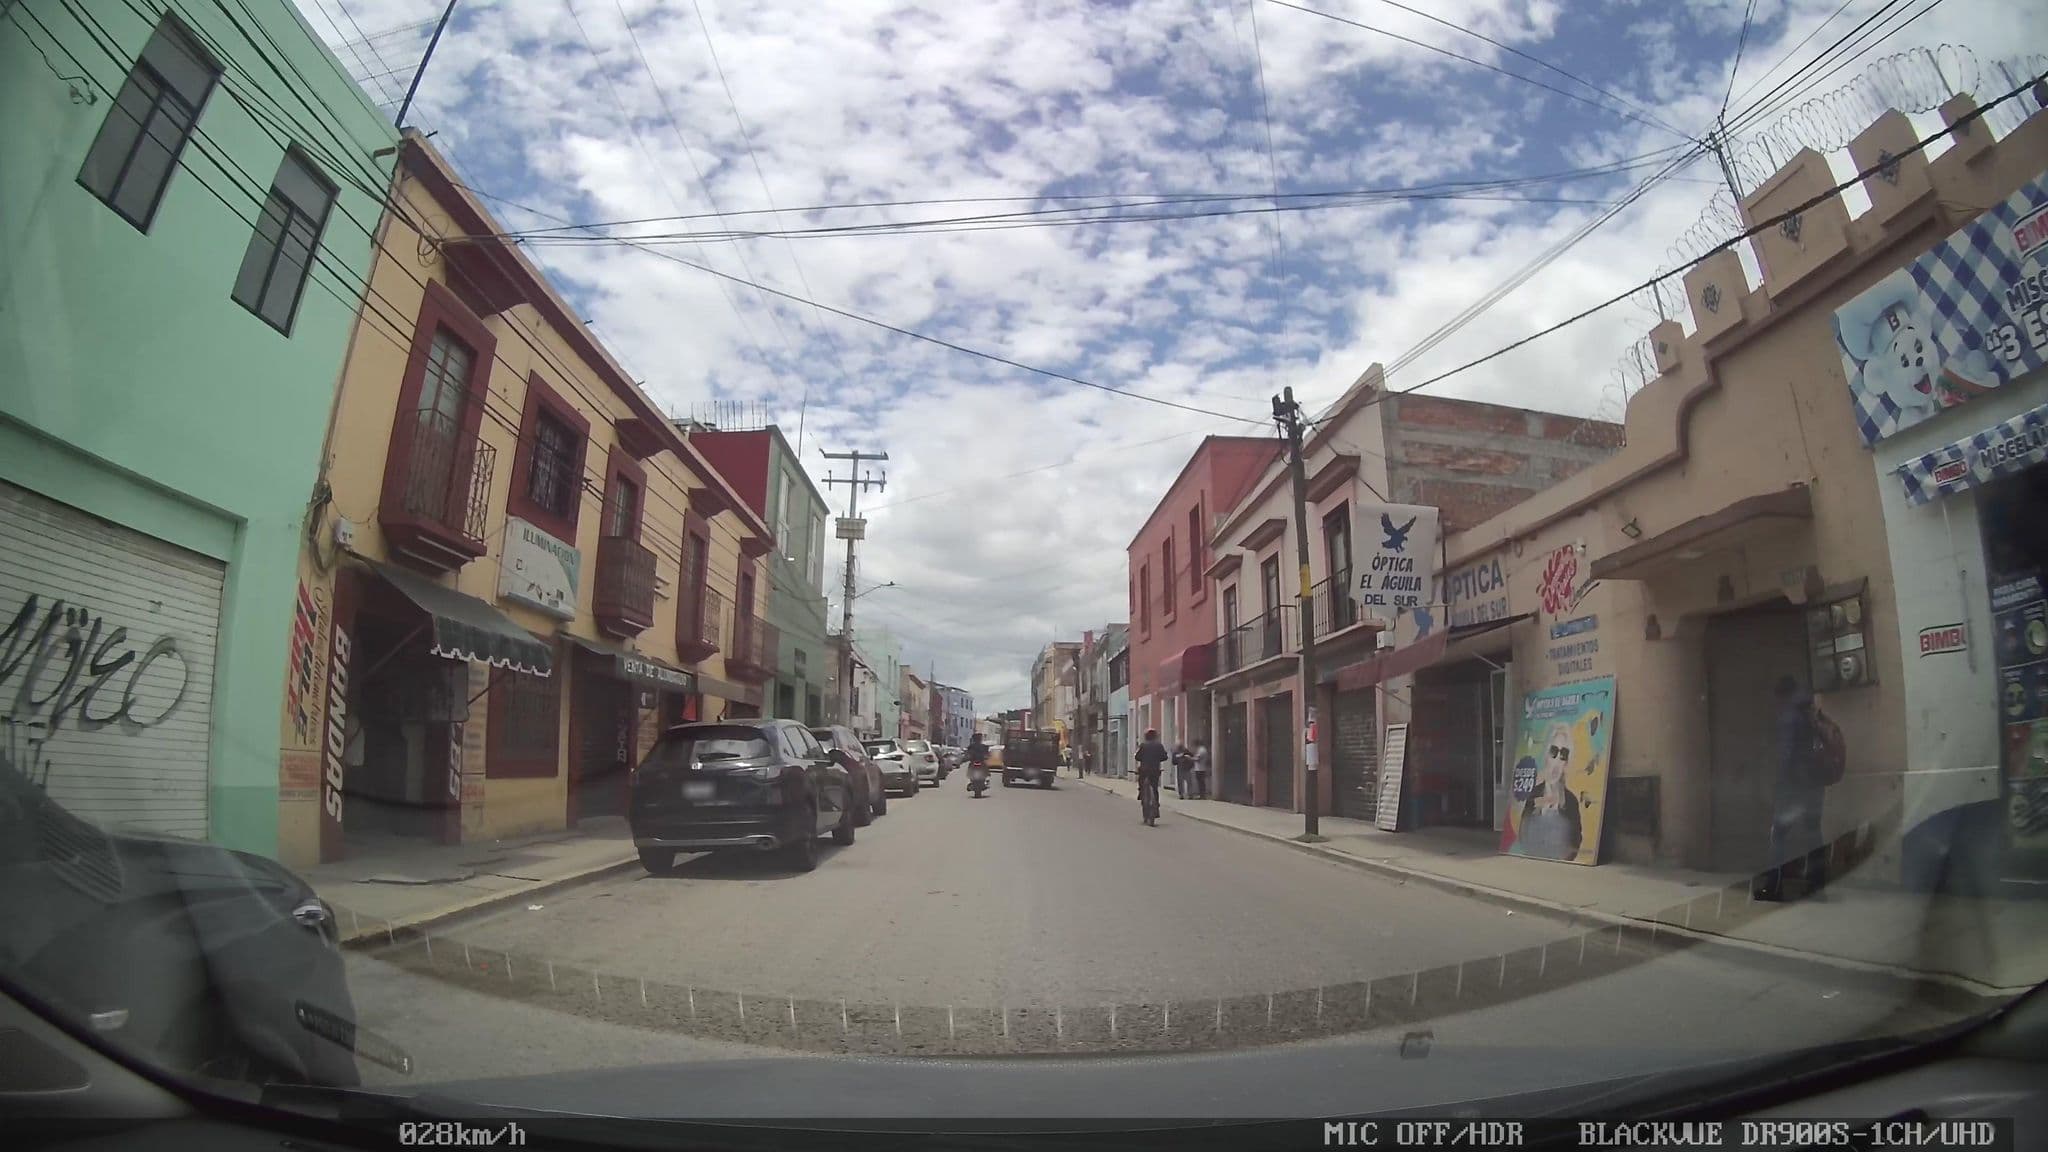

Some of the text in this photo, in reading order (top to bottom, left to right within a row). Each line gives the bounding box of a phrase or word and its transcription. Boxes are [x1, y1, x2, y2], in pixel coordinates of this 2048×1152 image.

[1360, 574, 1372, 589] EL
[1365, 594, 1418, 607] DEL SUR
[326, 623, 351, 823] BANDAS
[1513, 778, 1535, 793] $249
